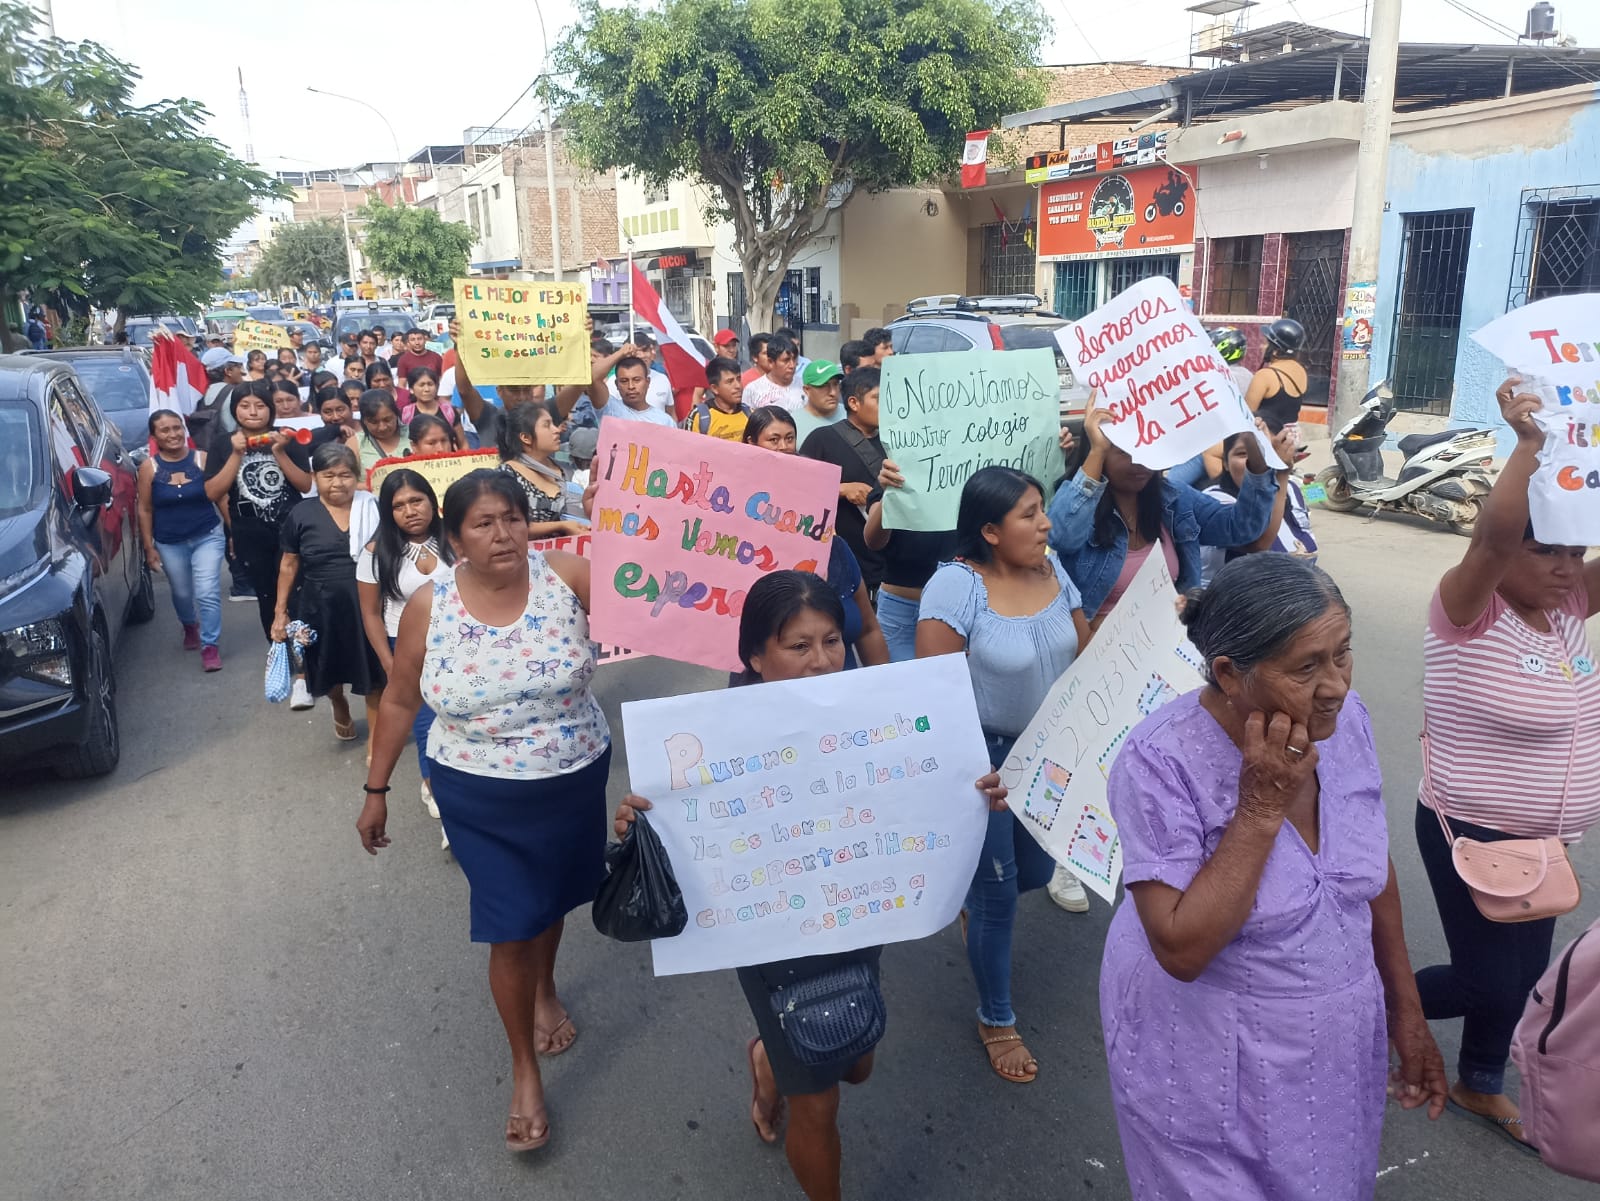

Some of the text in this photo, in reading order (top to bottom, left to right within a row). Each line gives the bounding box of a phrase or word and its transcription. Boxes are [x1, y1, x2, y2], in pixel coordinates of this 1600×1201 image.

[1048, 153, 1068, 166] KTM
[1070, 152, 1096, 162] YAMAHA
[1114, 137, 1138, 151] LS2
[658, 255, 688, 269] RICOH
[464, 285, 482, 300] EL
[536, 313, 570, 328] hijos
[1075, 296, 1177, 367] Señores
[1088, 322, 1199, 398] queremos
[961, 413, 1030, 446] colegio
[1134, 410, 1166, 448] la
[597, 503, 660, 541] más
[663, 713, 931, 791] Piurano escucha
[809, 777, 829, 795] a
[834, 770, 857, 792] la
[866, 756, 939, 786] lucha
[771, 815, 832, 844] hora
[838, 806, 876, 829] de
[908, 874, 925, 889] a
